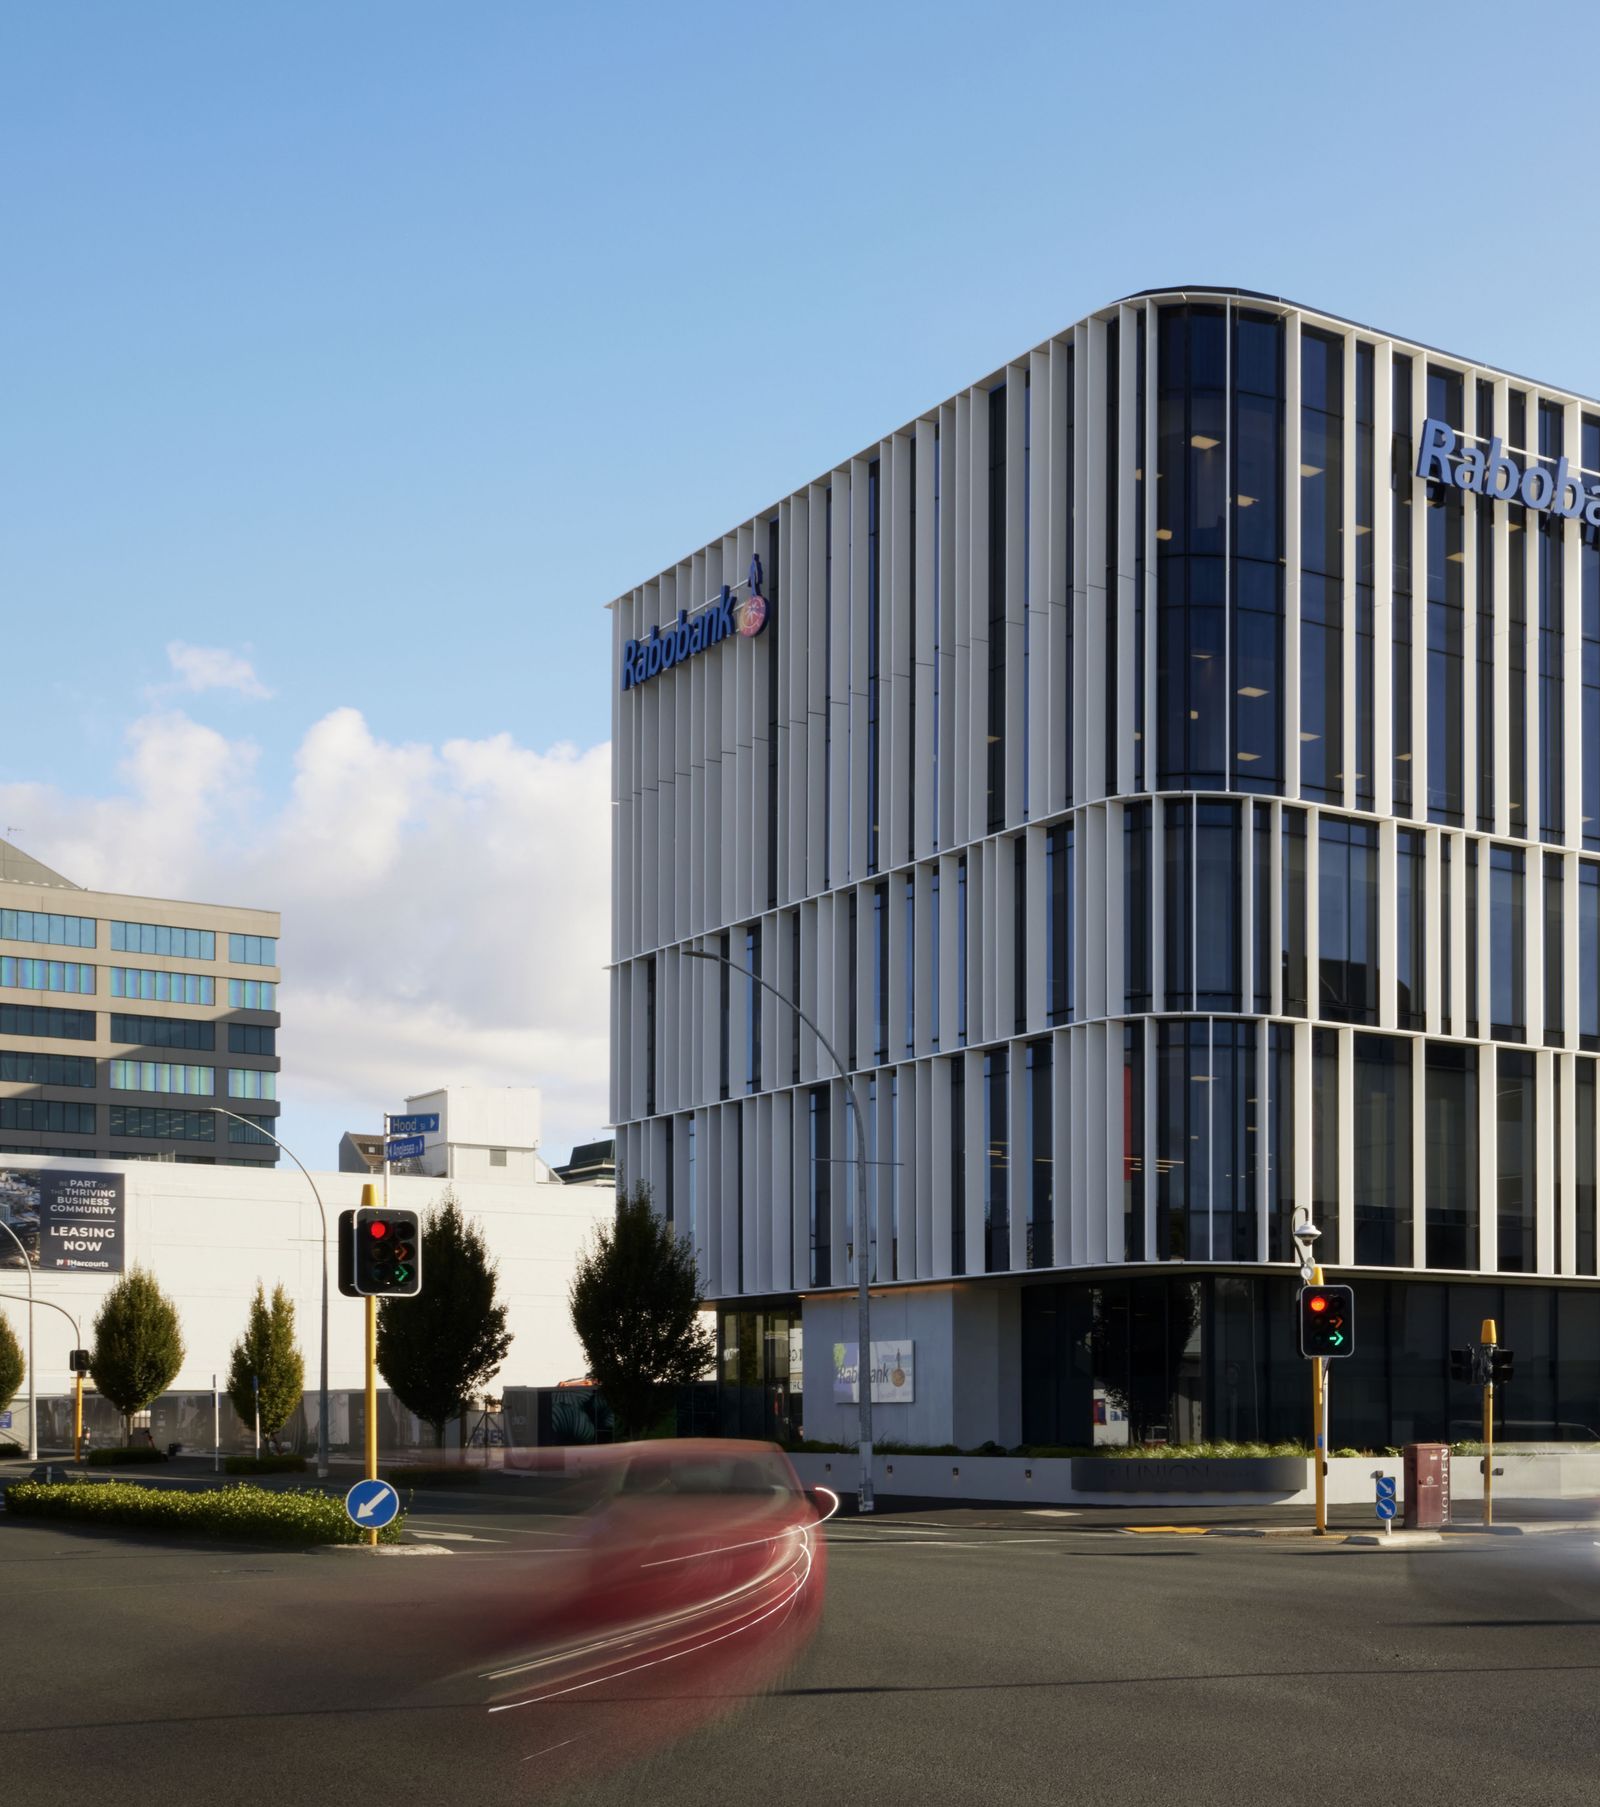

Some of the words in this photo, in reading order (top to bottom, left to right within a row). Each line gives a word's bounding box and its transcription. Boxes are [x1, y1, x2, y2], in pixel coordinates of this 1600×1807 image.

[622, 585, 737, 691] Rabobank
[392, 1117, 416, 1131] Hood
[70, 1179, 97, 1188] PART
[65, 1188, 116, 1198] THRIVING
[57, 1196, 110, 1206] BUSINESS
[50, 1204, 116, 1215] COMMUNITY
[50, 1226, 115, 1238] LEASING
[63, 1240, 102, 1252] NOW
